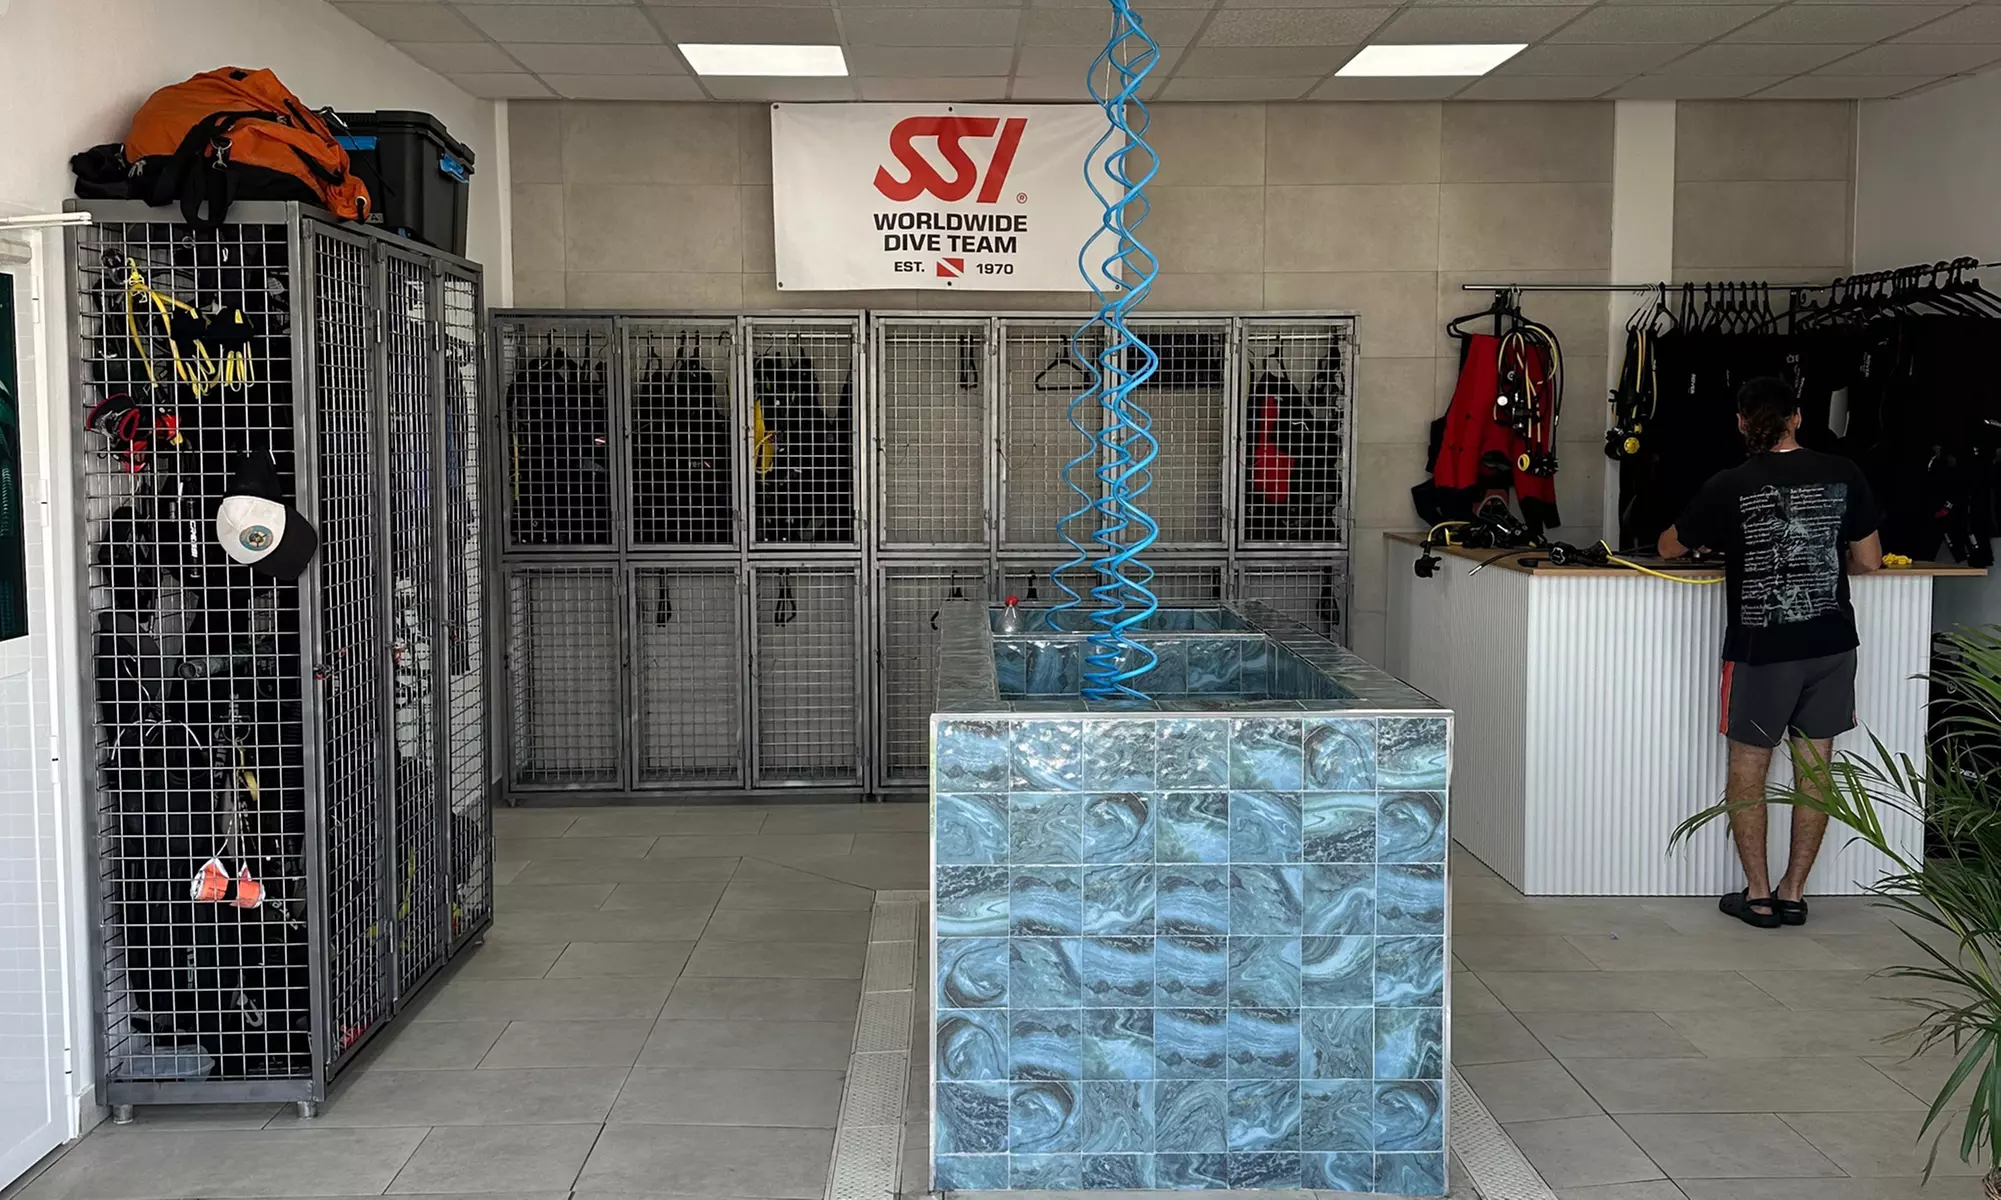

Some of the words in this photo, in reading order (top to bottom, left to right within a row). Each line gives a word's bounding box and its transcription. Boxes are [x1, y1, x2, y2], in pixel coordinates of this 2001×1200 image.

[873, 116, 1028, 203] SSI
[873, 212, 1028, 232] WORLDWIDE
[884, 234, 940, 252] DIVE
[947, 235, 1017, 253] TEAM
[894, 261, 925, 273] EST.
[976, 263, 1014, 275] 1970
